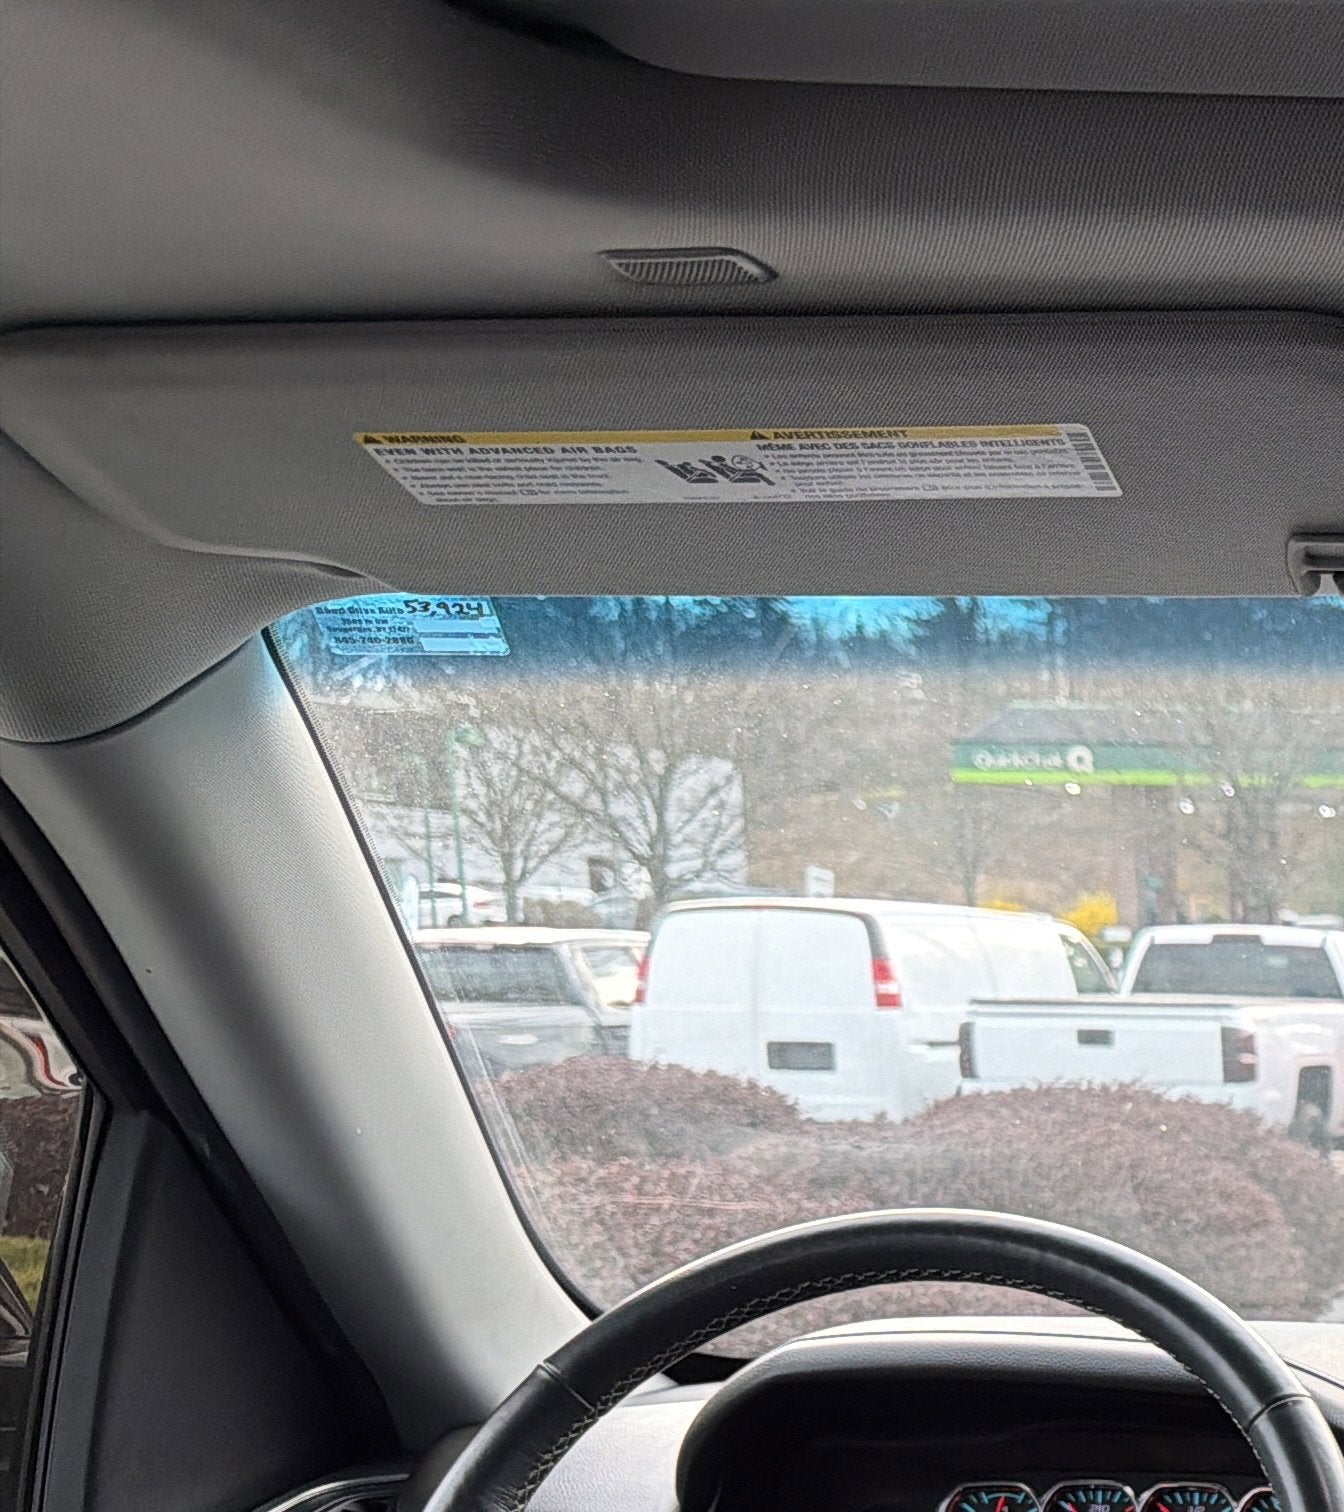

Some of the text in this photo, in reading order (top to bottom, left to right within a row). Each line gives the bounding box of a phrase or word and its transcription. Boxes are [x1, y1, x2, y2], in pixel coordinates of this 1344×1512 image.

[384, 435, 467, 444] WARNING
[773, 430, 908, 440] AVERTISSEMENT
[799, 443, 831, 451] AVEC
[834, 442, 861, 450] DES
[862, 442, 895, 450] SACS
[897, 440, 978, 449] GONFLABLES
[979, 438, 1066, 448] INTELLIGENTS
[374, 445, 638, 456] EVEN WITH ADVANCED AIR BAGS
[403, 599, 483, 617] 53,924
